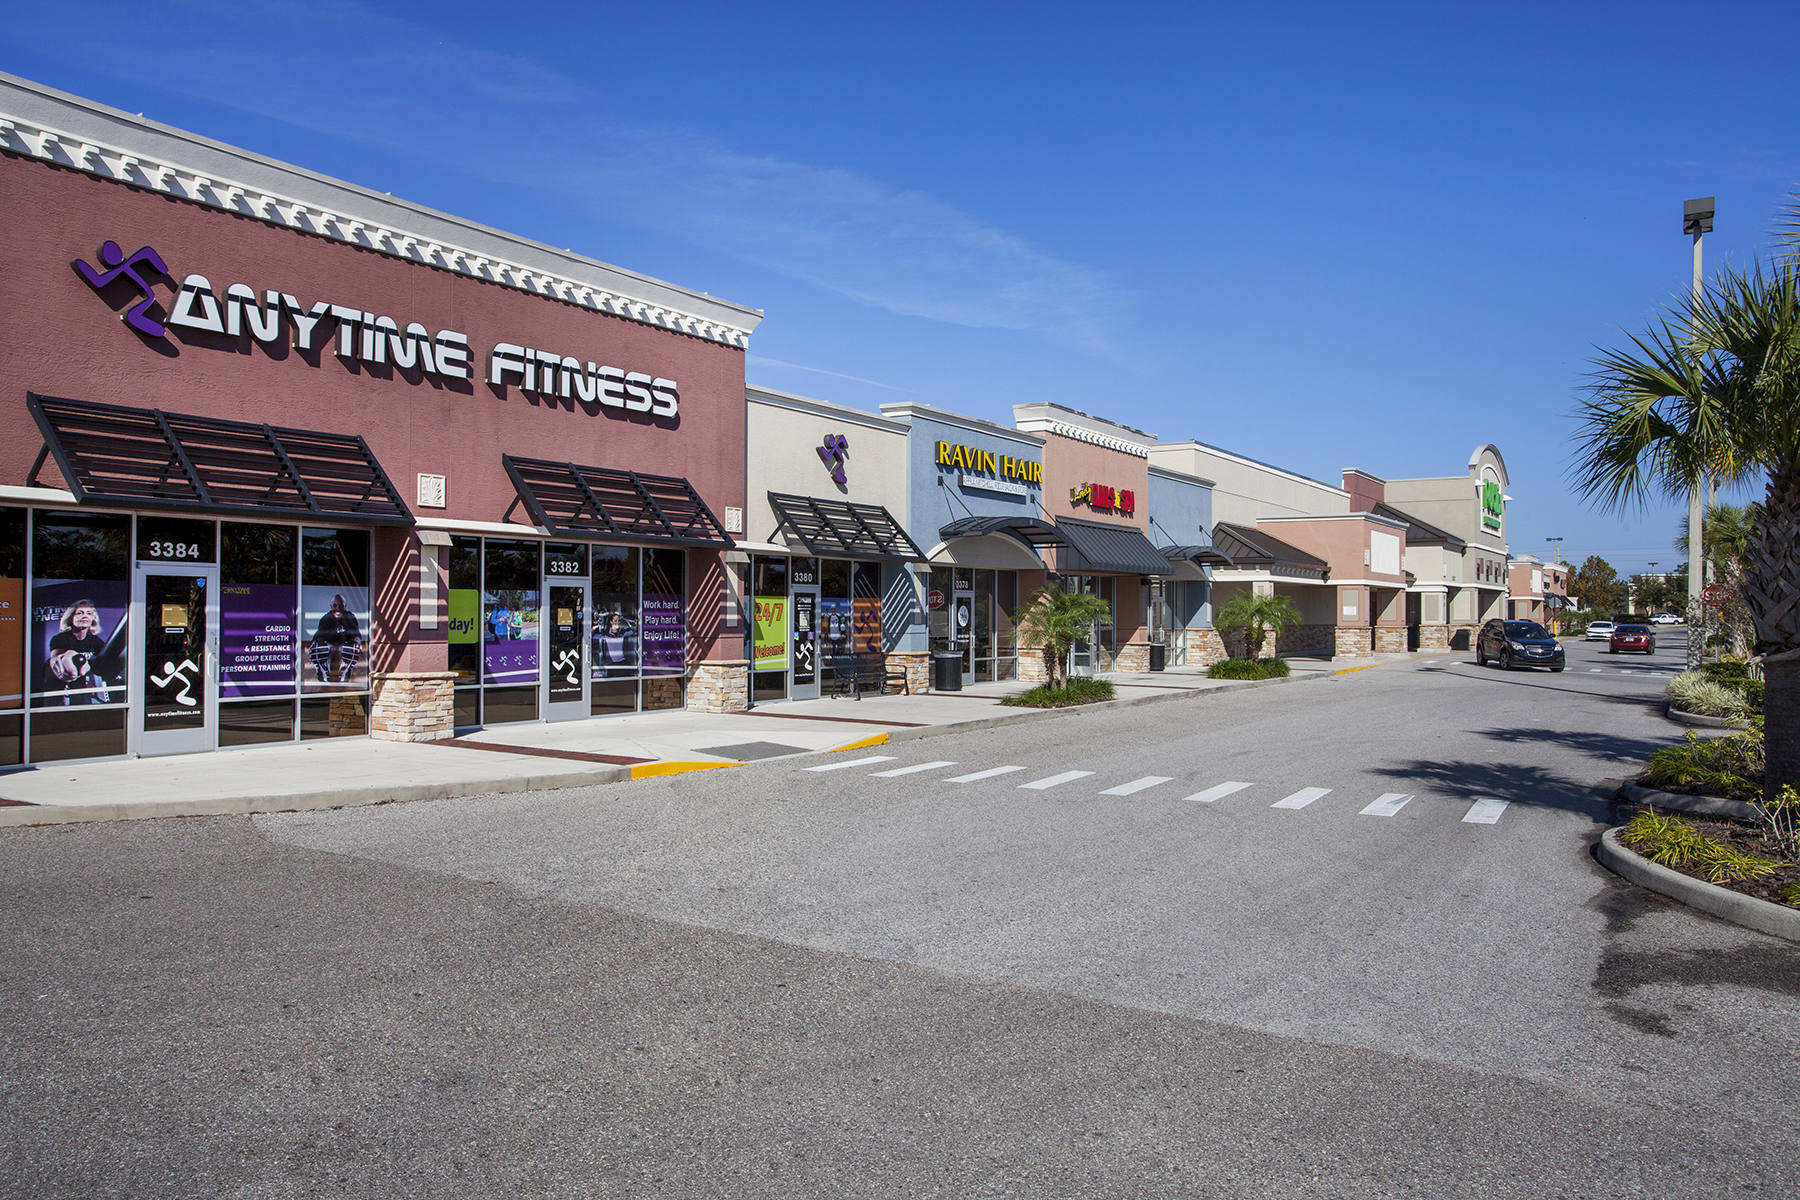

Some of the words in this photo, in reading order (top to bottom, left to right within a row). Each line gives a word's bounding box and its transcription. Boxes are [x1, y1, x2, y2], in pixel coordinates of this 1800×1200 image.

[167, 273, 468, 379] ANYTIME
[490, 342, 678, 418] FITNESS
[938, 441, 996, 474] RAVIN
[1003, 455, 1042, 483] HAIR
[150, 541, 199, 558] 3384
[550, 560, 579, 573] 3382
[794, 572, 813, 582] 3380
[643, 600, 661, 608] Work
[662, 600, 680, 609] hard.
[644, 615, 660, 626] Play
[660, 615, 679, 624] hard.
[754, 603, 784, 627] 24/7
[449, 617, 474, 634] day!
[643, 631, 662, 641] Enjoy
[664, 630, 680, 639] Life!
[251, 644, 291, 652] RESISTANCE
[754, 642, 785, 658] Welcome!
[221, 665, 257, 673] PERSONAL
